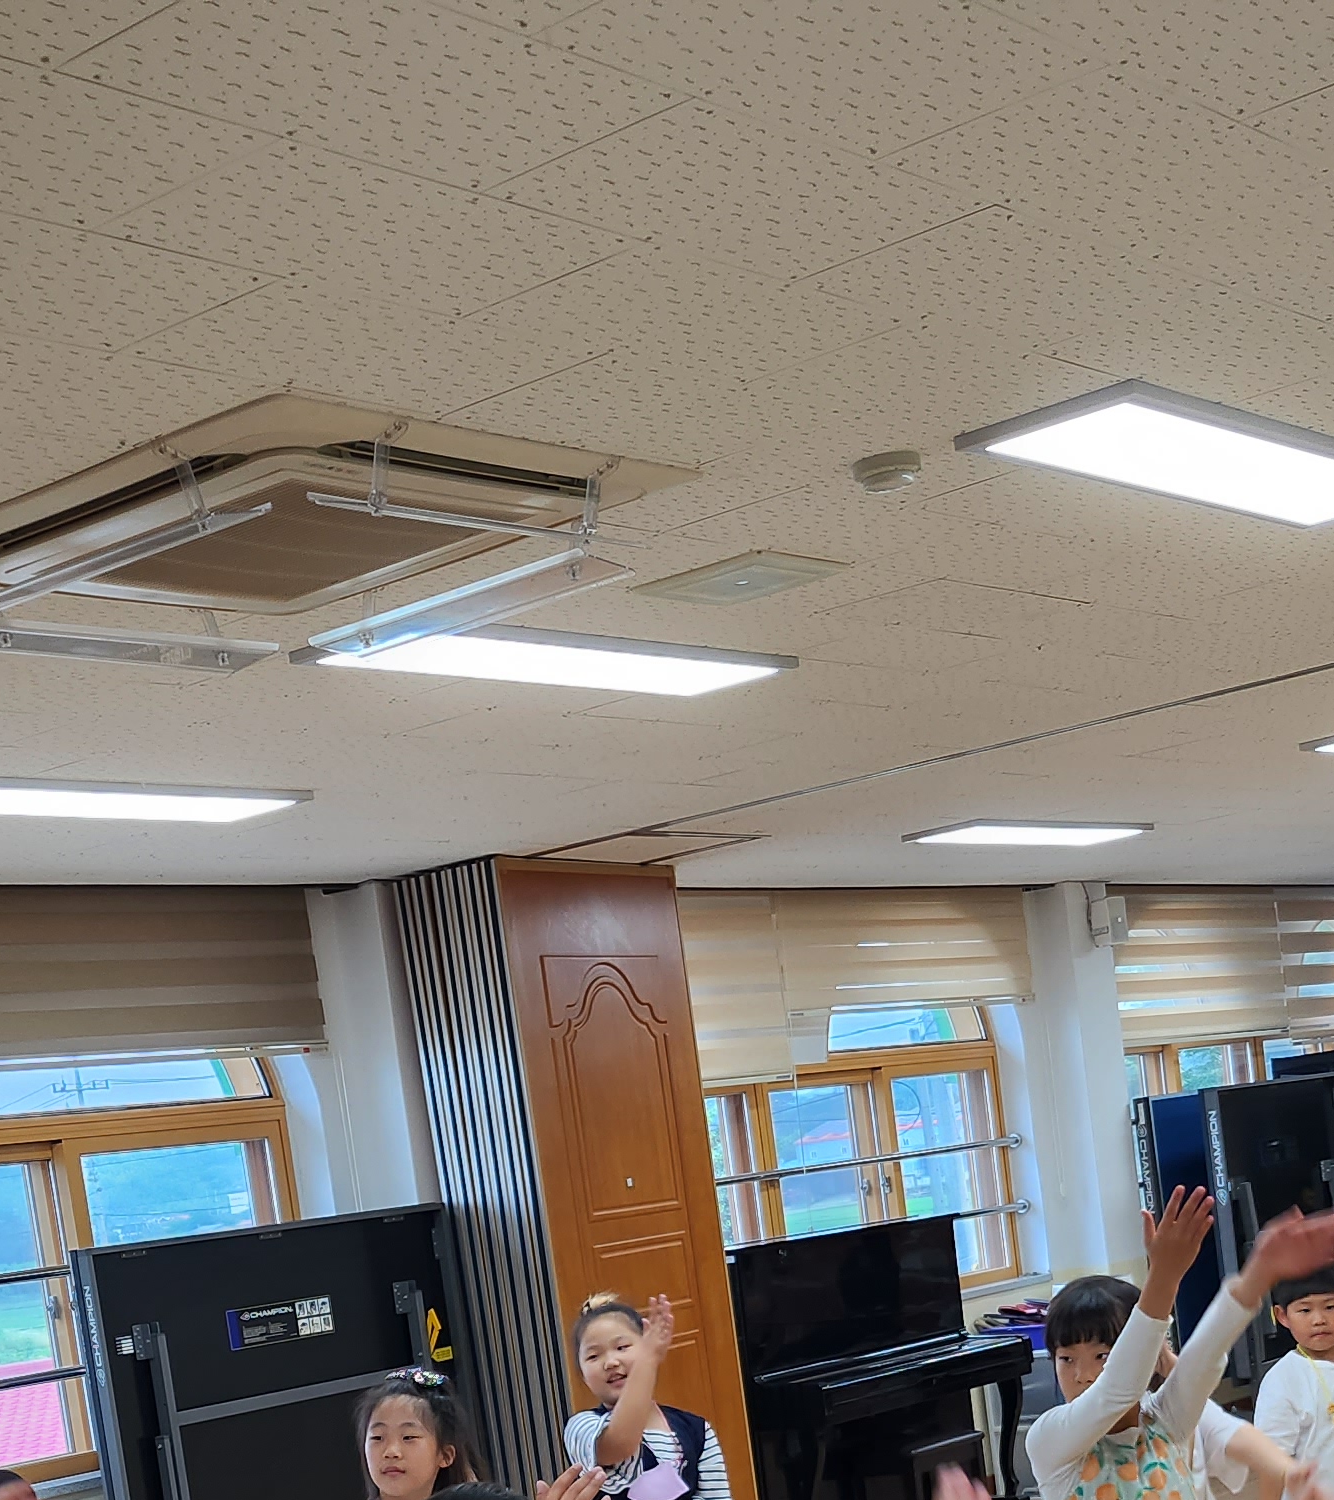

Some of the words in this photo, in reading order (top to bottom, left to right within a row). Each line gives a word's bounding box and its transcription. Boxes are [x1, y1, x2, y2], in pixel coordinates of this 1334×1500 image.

[1139, 1139, 1156, 1215] CHAMPION
[1208, 1110, 1225, 1188] CHAMPION
[83, 1285, 102, 1367] CHAMPION
[250, 1305, 292, 1319] CHAMPION
